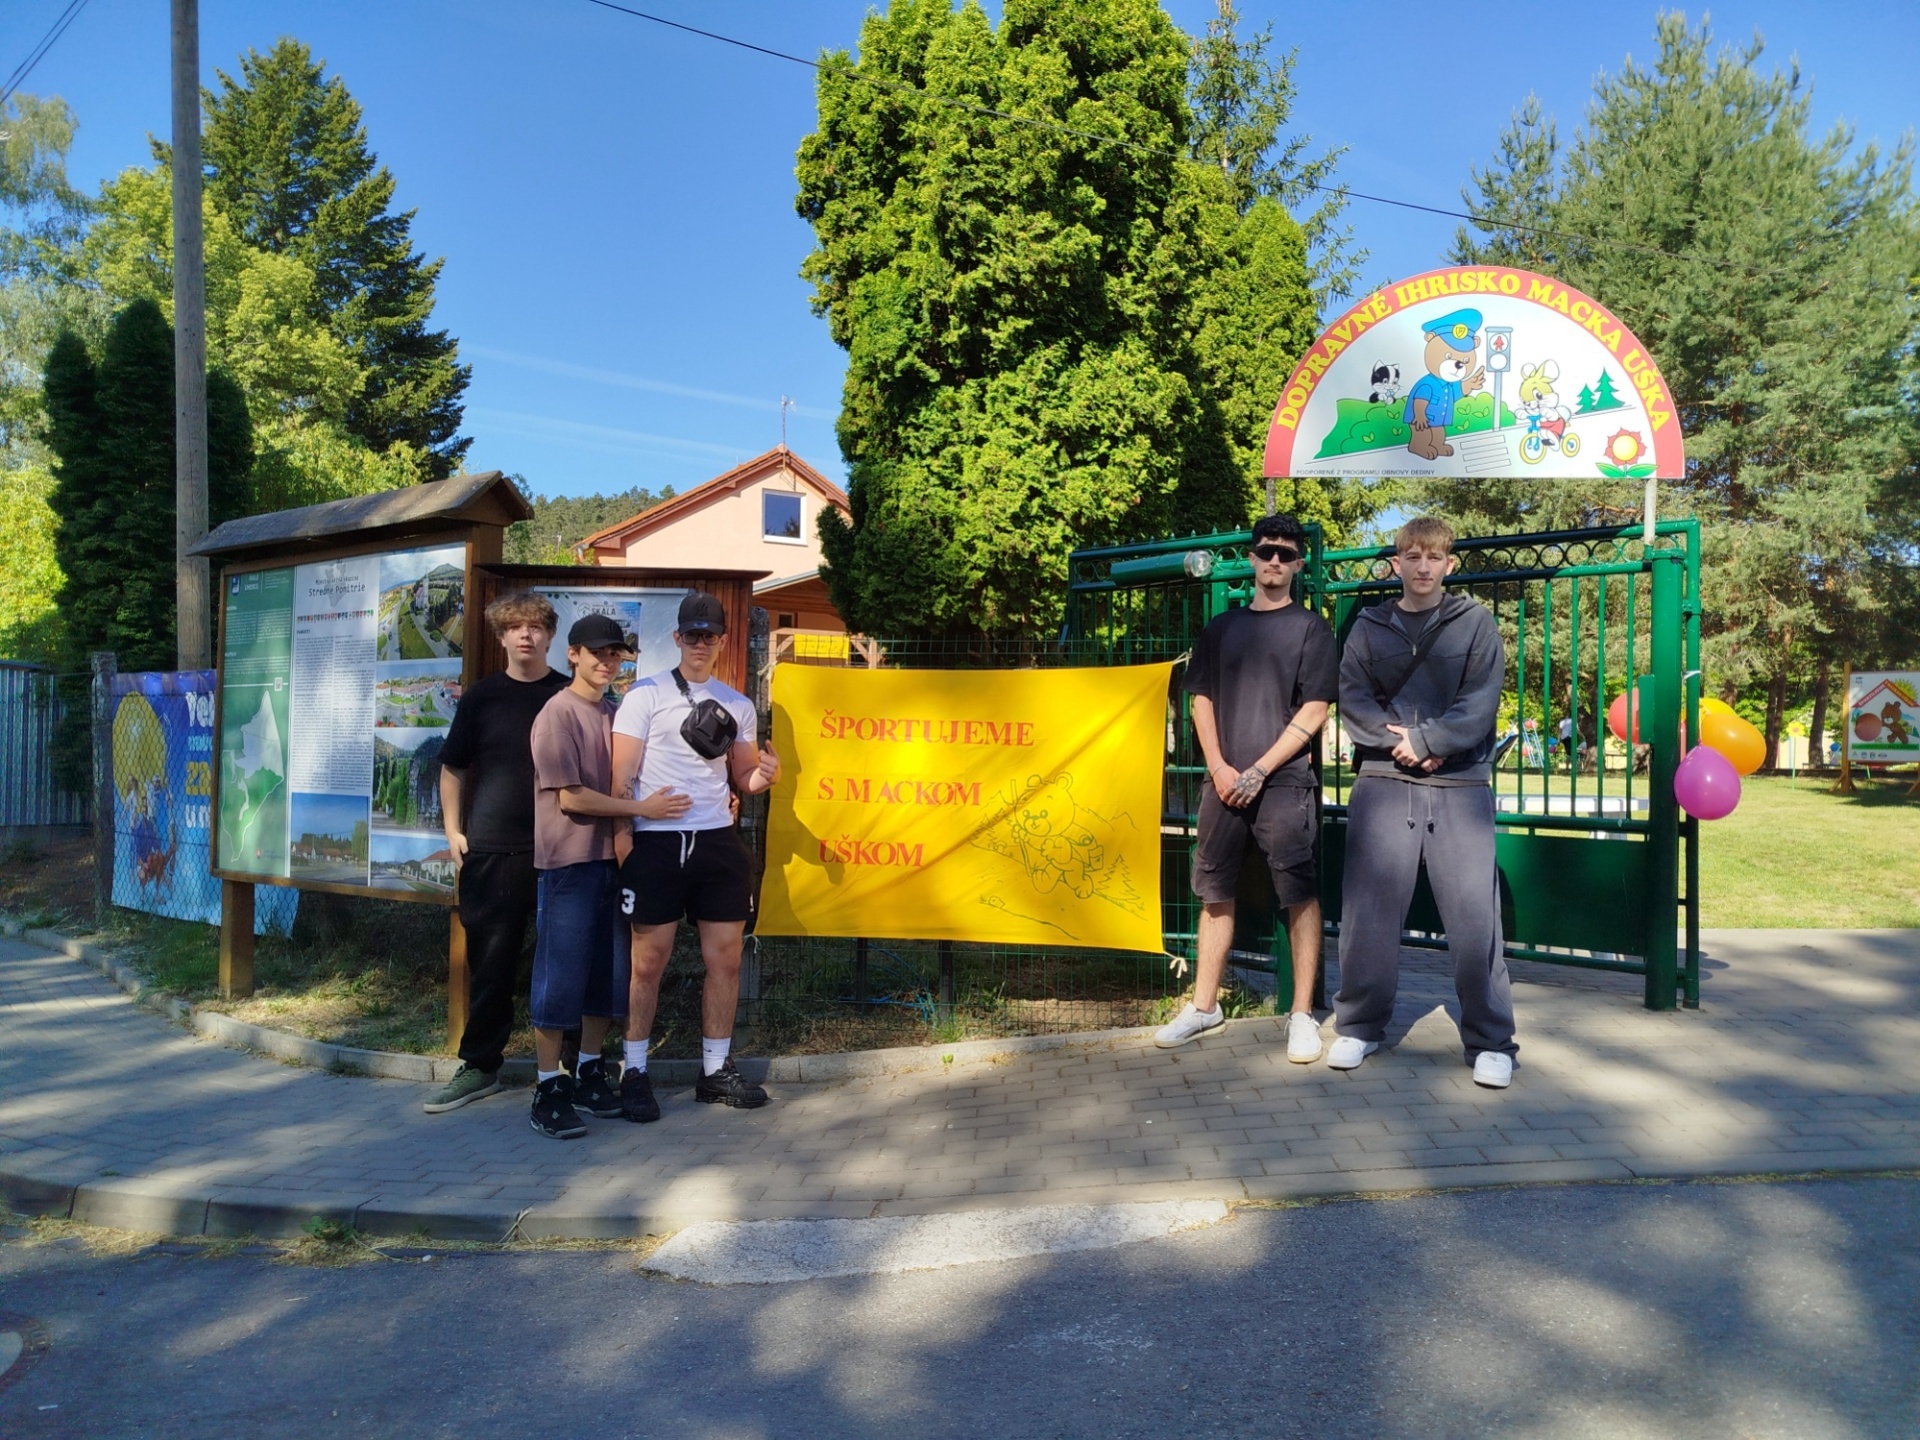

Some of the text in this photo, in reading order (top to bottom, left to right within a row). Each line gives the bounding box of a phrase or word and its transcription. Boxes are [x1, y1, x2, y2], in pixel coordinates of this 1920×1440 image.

[1276, 271, 1671, 432] DOPRAVNÉ IHRISKO MACKA UŠKA
[820, 708, 1035, 747] ŠPORTUJEME
[817, 776, 983, 806] S MACKOM
[819, 833, 925, 868] UŠKOM
[621, 888, 636, 915] 3
